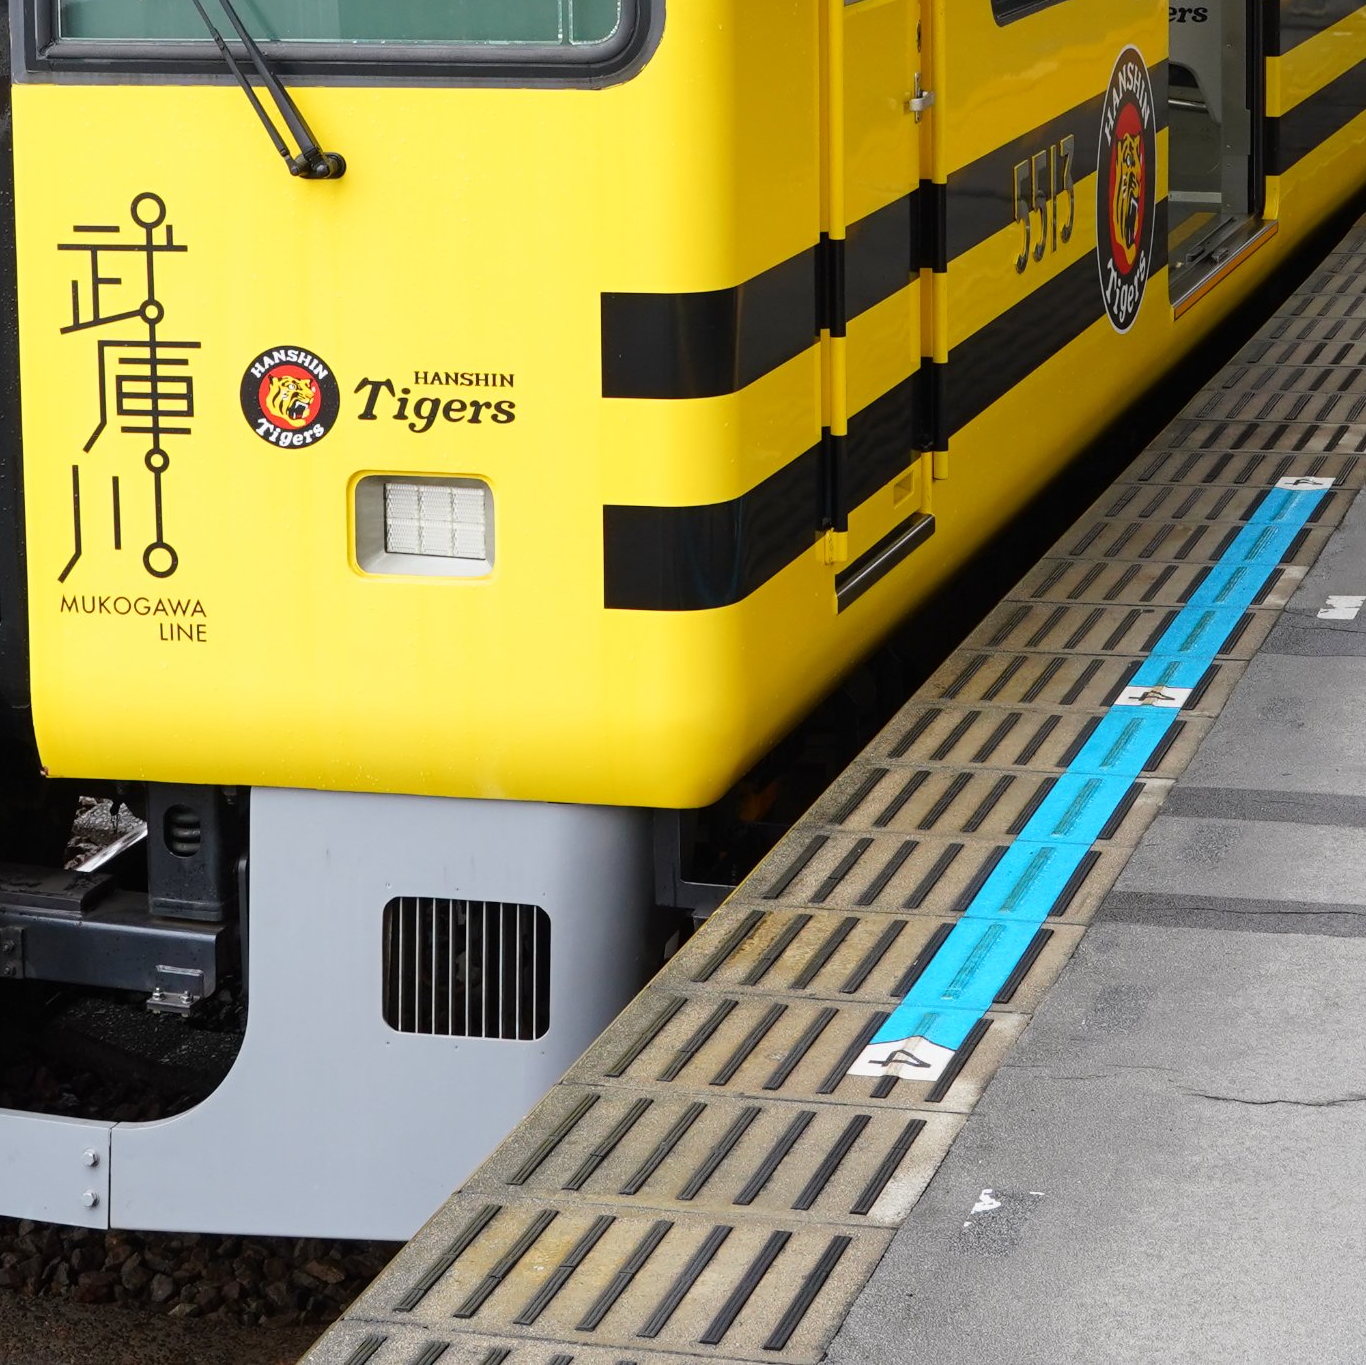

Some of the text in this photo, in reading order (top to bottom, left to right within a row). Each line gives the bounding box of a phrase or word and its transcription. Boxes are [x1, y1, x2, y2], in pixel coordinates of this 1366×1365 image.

[1104, 60, 1150, 147] HANSHIN
[1013, 134, 1075, 275] 5513
[1105, 248, 1147, 323] Tigers
[249, 348, 329, 380] HANSHIN
[413, 370, 515, 388] HANSHIN
[56, 190, 202, 584] 武庫川
[353, 376, 517, 434] Tigers
[254, 417, 325, 447] Tigers
[59, 594, 208, 618] MUKOGAWA
[158, 622, 208, 642] LINE
